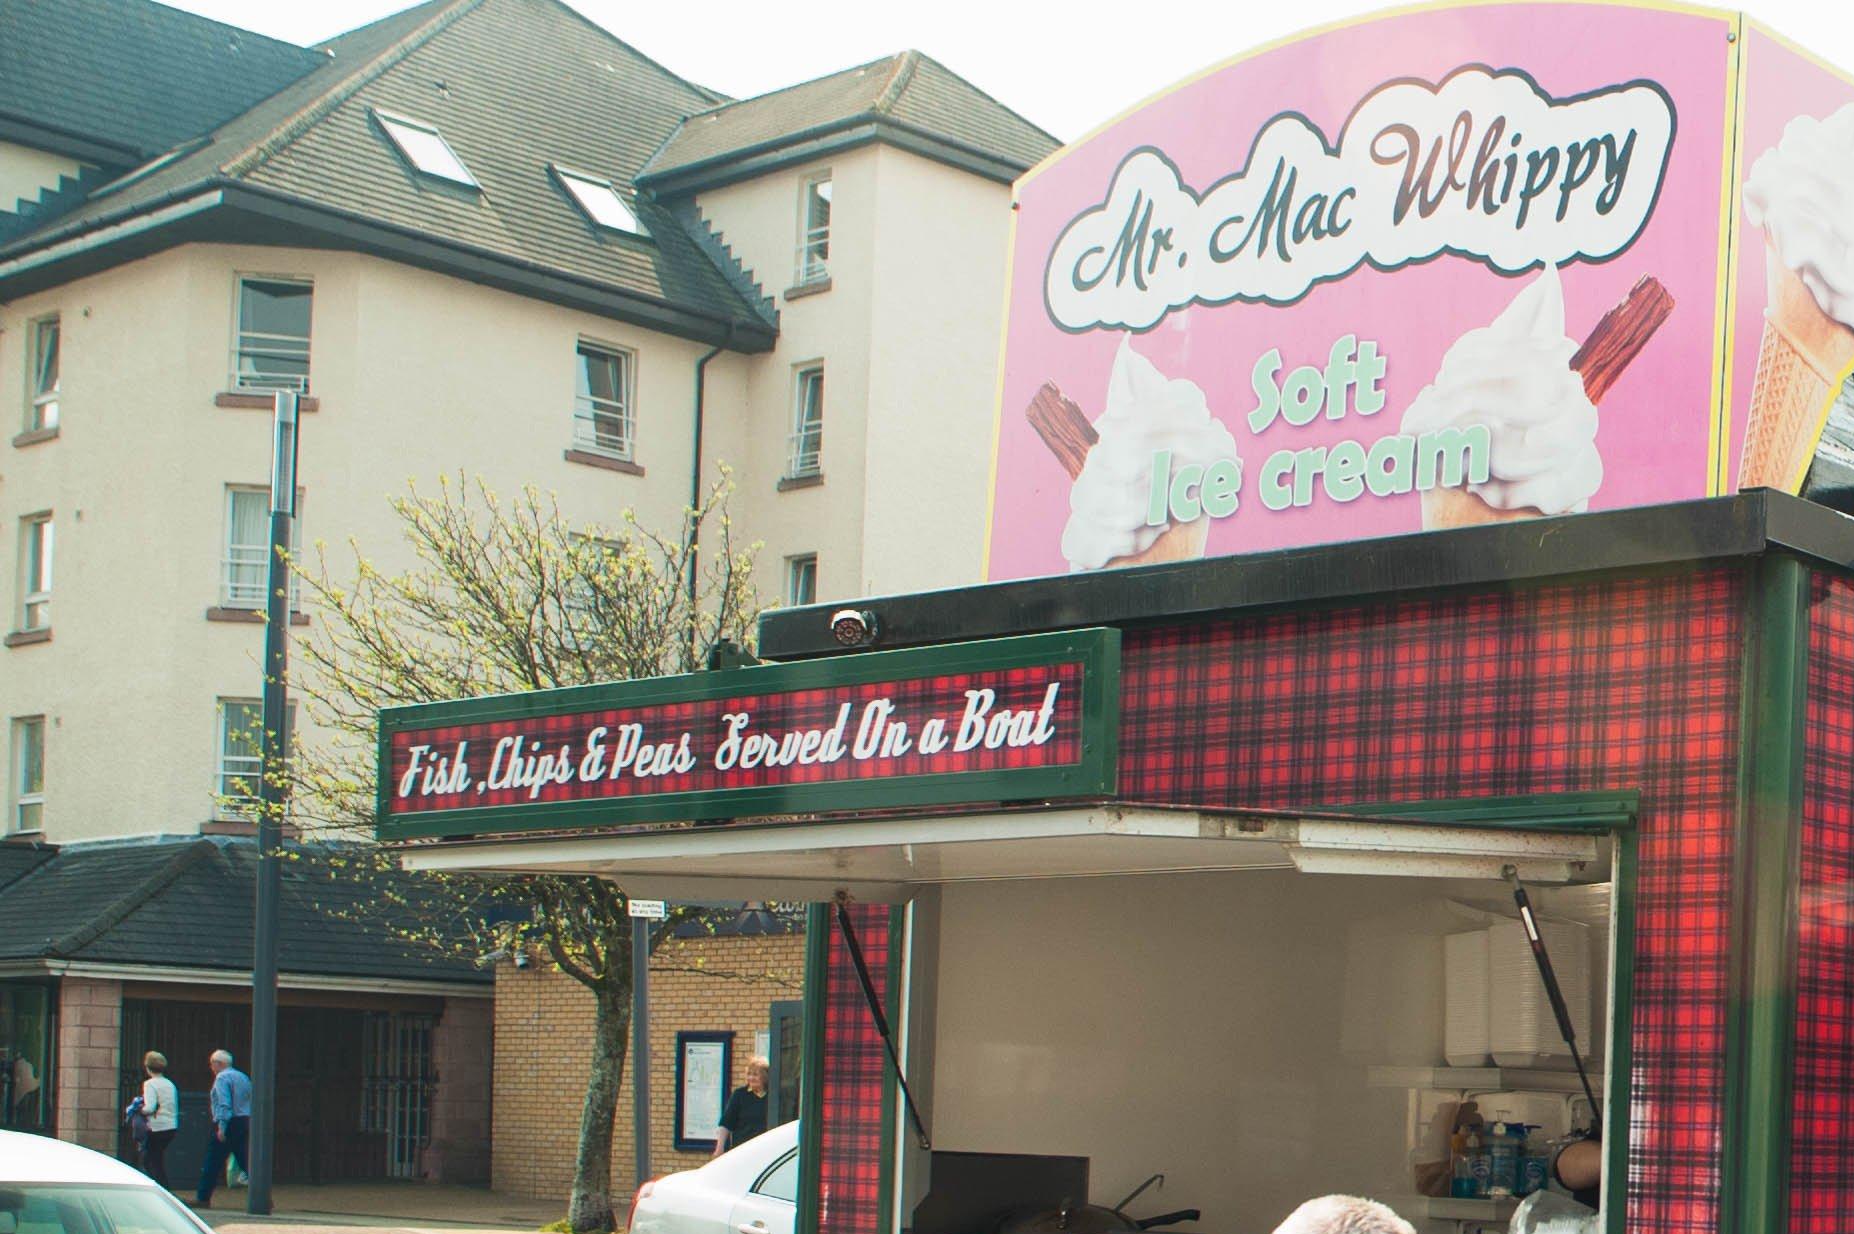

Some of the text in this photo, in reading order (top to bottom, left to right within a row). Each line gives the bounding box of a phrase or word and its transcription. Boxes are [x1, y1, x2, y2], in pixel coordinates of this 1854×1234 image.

[1071, 109, 1638, 292] Mr. Mac Whippy
[1249, 334, 1387, 434] Soft
[1145, 423, 1491, 527] Ice cream
[399, 740, 471, 799] Fish
[579, 727, 607, 781] &
[609, 722, 697, 778] Peas
[714, 703, 849, 771] Served
[852, 697, 912, 759] On
[919, 724, 947, 756] a
[953, 682, 1062, 753] Boat
